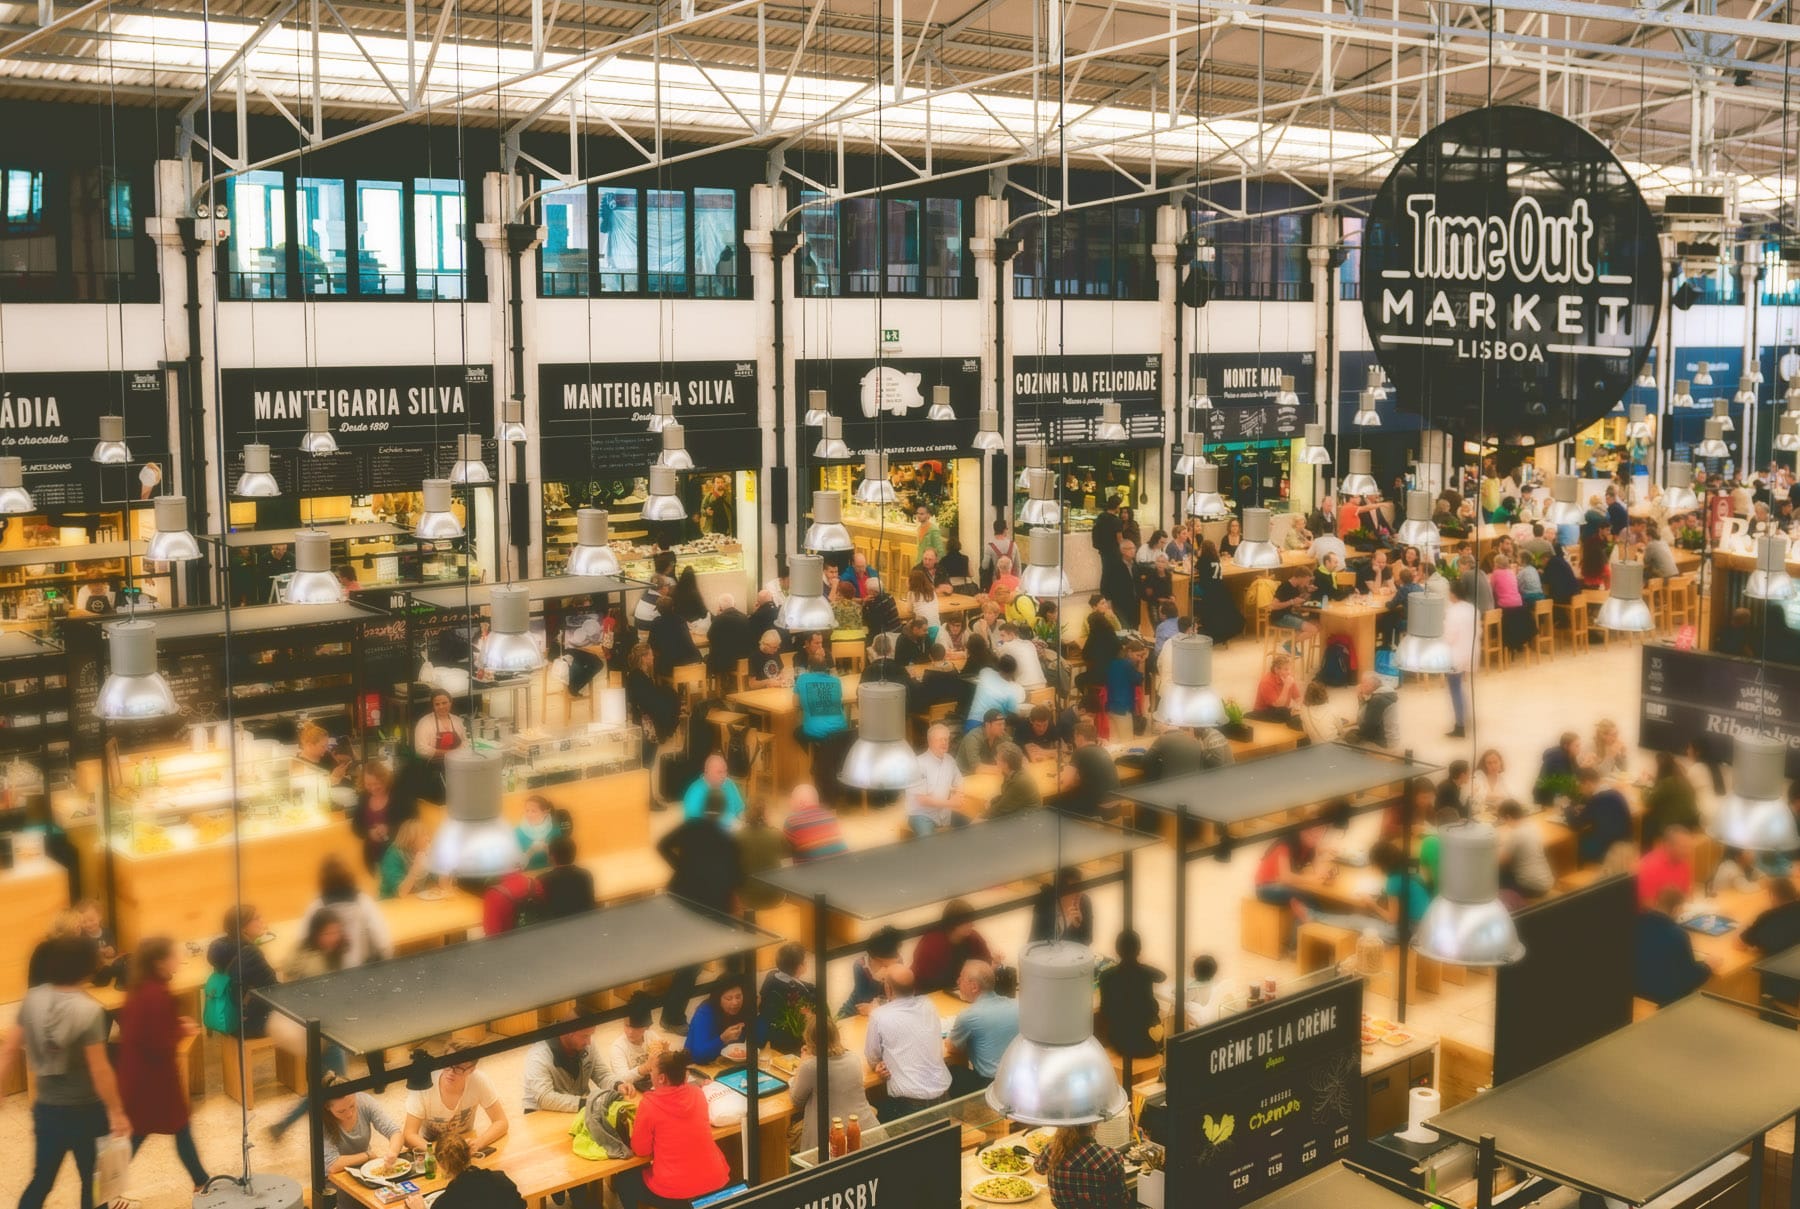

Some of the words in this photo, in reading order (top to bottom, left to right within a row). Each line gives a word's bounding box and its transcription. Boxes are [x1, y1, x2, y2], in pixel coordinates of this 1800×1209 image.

[1382, 288, 1630, 336] MARKET
[1457, 339, 1544, 363] LISBOA
[1015, 371, 1068, 395] COZINHA
[1072, 371, 1089, 393] DA
[1092, 370, 1157, 393] FELICIDADE
[1223, 368, 1258, 389] MONTE
[1260, 367, 1282, 387] MAR
[254, 388, 400, 420] MANTEIGARIA
[408, 386, 465, 416] SILVA
[688, 379, 735, 406] SILVA
[18, 434, 69, 445] chocolate
[339, 422, 367, 433] Desde
[369, 422, 390, 431] 1890
[1210, 1036, 1253, 1074] CRÈME
[1258, 1029, 1273, 1057] DE
[1278, 1022, 1293, 1049] LA
[1297, 1005, 1337, 1041] CRÈME
[794, 1178, 879, 1209] RSBY
